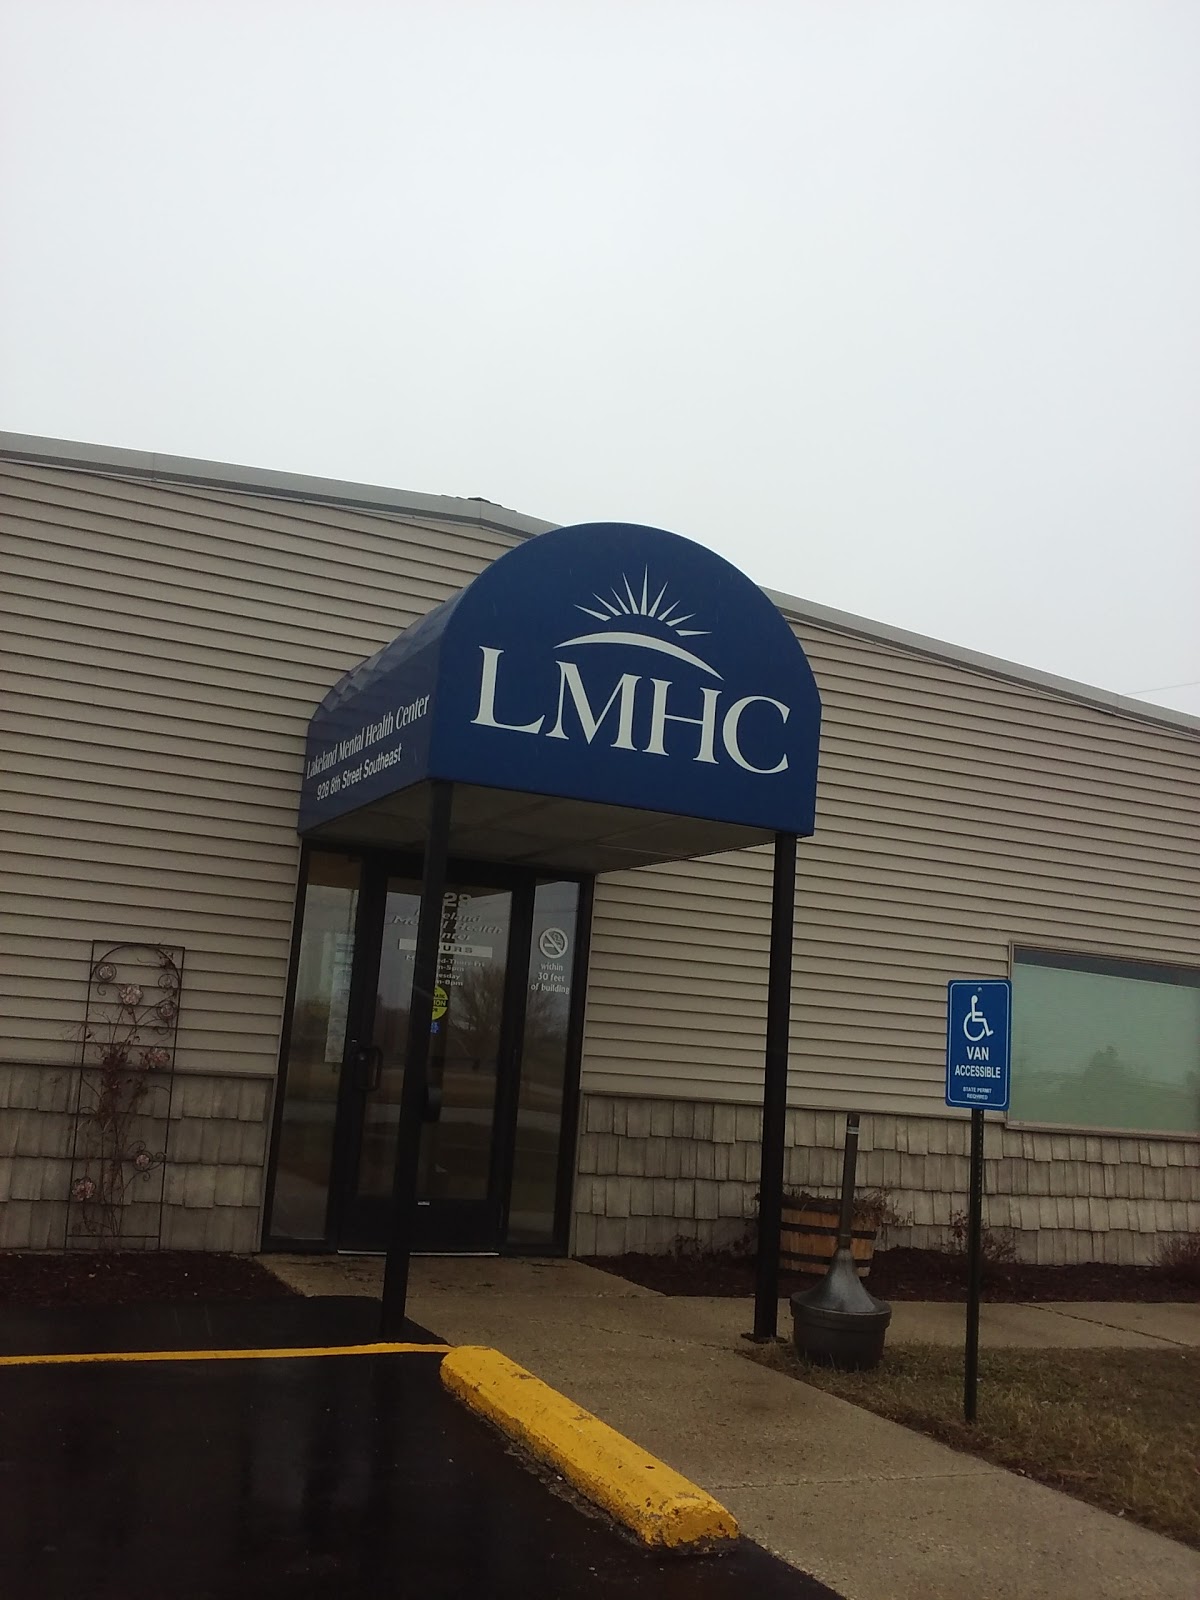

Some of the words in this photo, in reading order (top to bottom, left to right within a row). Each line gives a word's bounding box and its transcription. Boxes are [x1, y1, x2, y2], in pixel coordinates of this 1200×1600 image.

[470, 645, 791, 775] LMHC
[306, 743, 339, 780] Lakeland
[338, 726, 365, 762] Mental
[365, 711, 394, 748] Health
[395, 694, 430, 730] Center
[316, 783, 330, 801] 928
[330, 776, 341, 795] 8th
[341, 762, 363, 789] Street
[363, 742, 402, 778] Southeast
[443, 892, 472, 907] 28
[540, 962, 564, 972] within
[537, 972, 549, 981] 30
[550, 973, 565, 983] feet
[530, 983, 539, 991] of
[541, 983, 570, 995] building
[966, 1046, 989, 1061] VAN
[954, 1064, 1001, 1078] ACCESSIBLE
